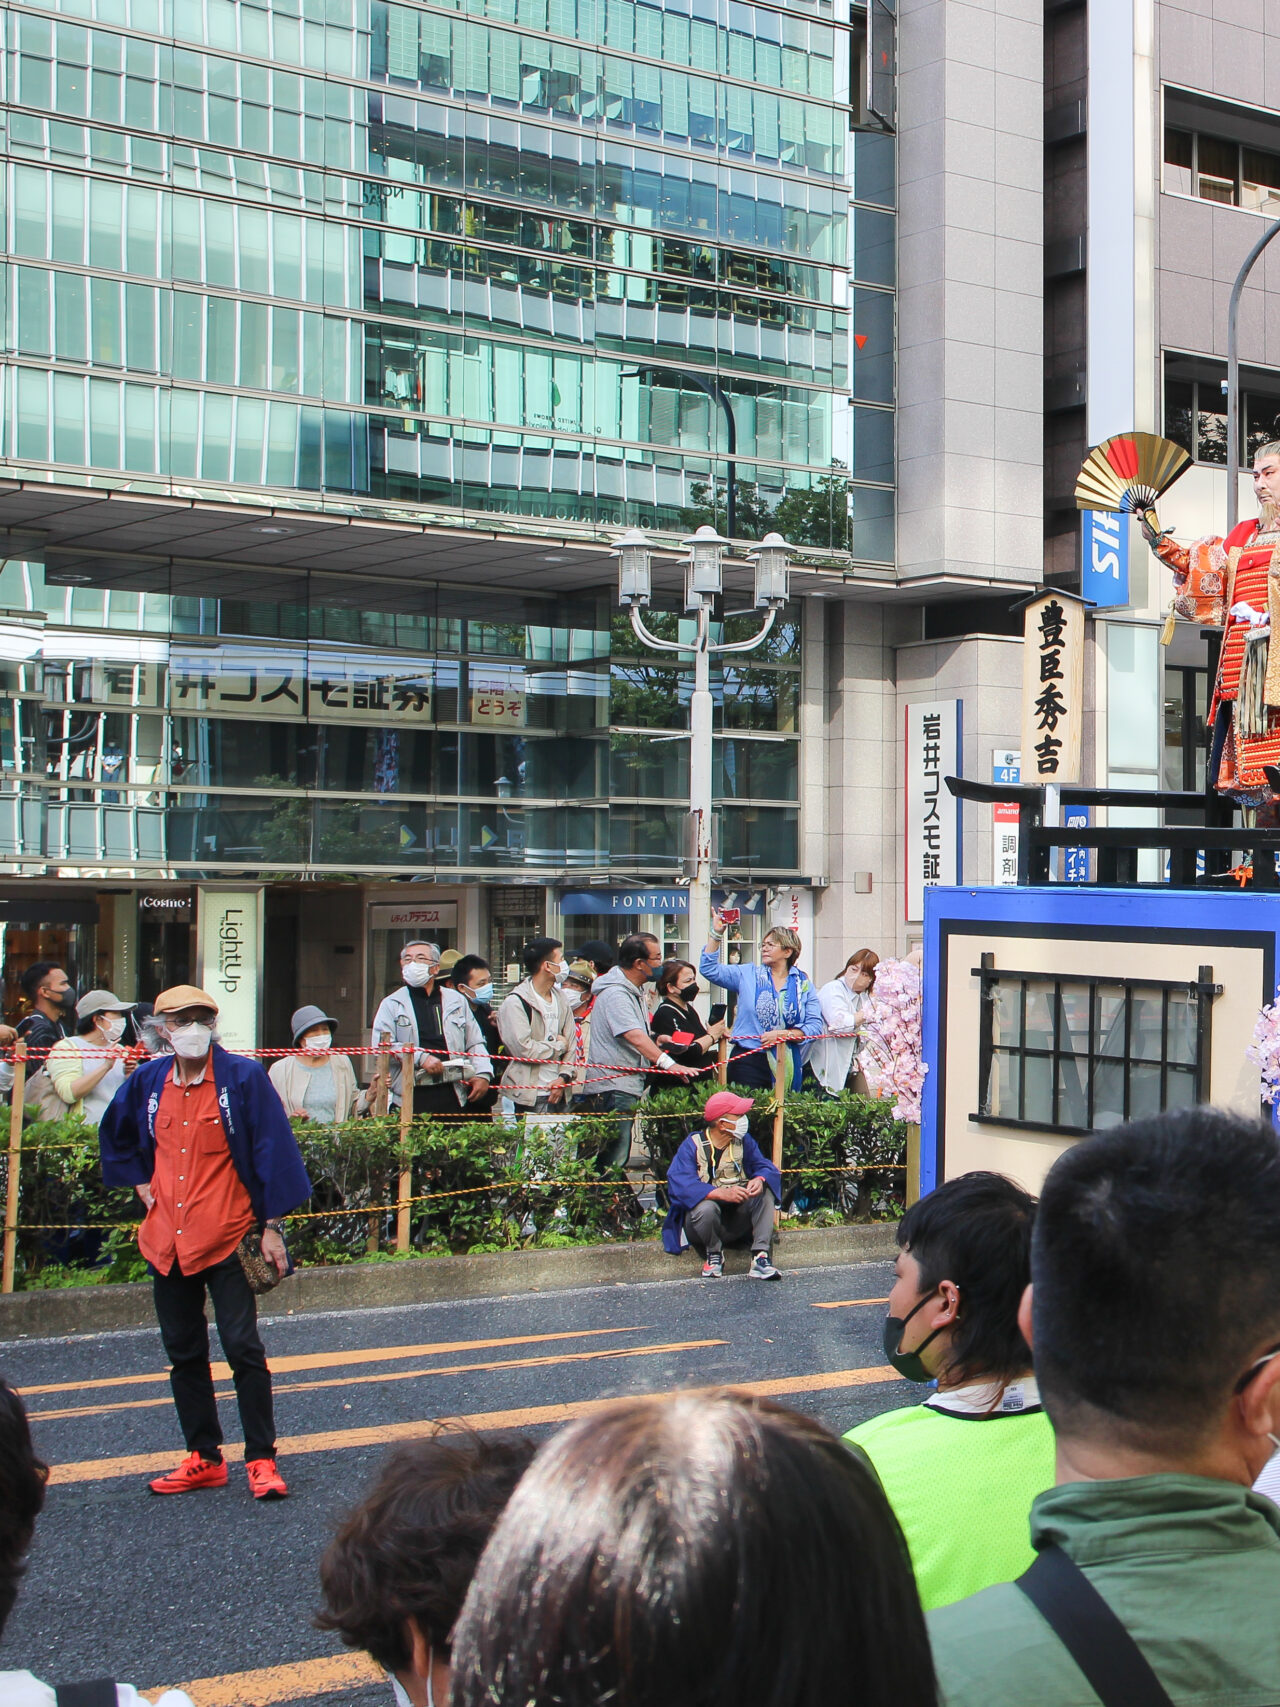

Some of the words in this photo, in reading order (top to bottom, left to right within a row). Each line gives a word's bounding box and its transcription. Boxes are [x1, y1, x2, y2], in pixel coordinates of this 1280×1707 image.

[477, 699, 523, 718] どうぞ
[1034, 600, 1068, 775] 豊臣秀吉
[923, 713, 941, 886] 岩井コスモ証
[1000, 768, 1018, 782] 4F
